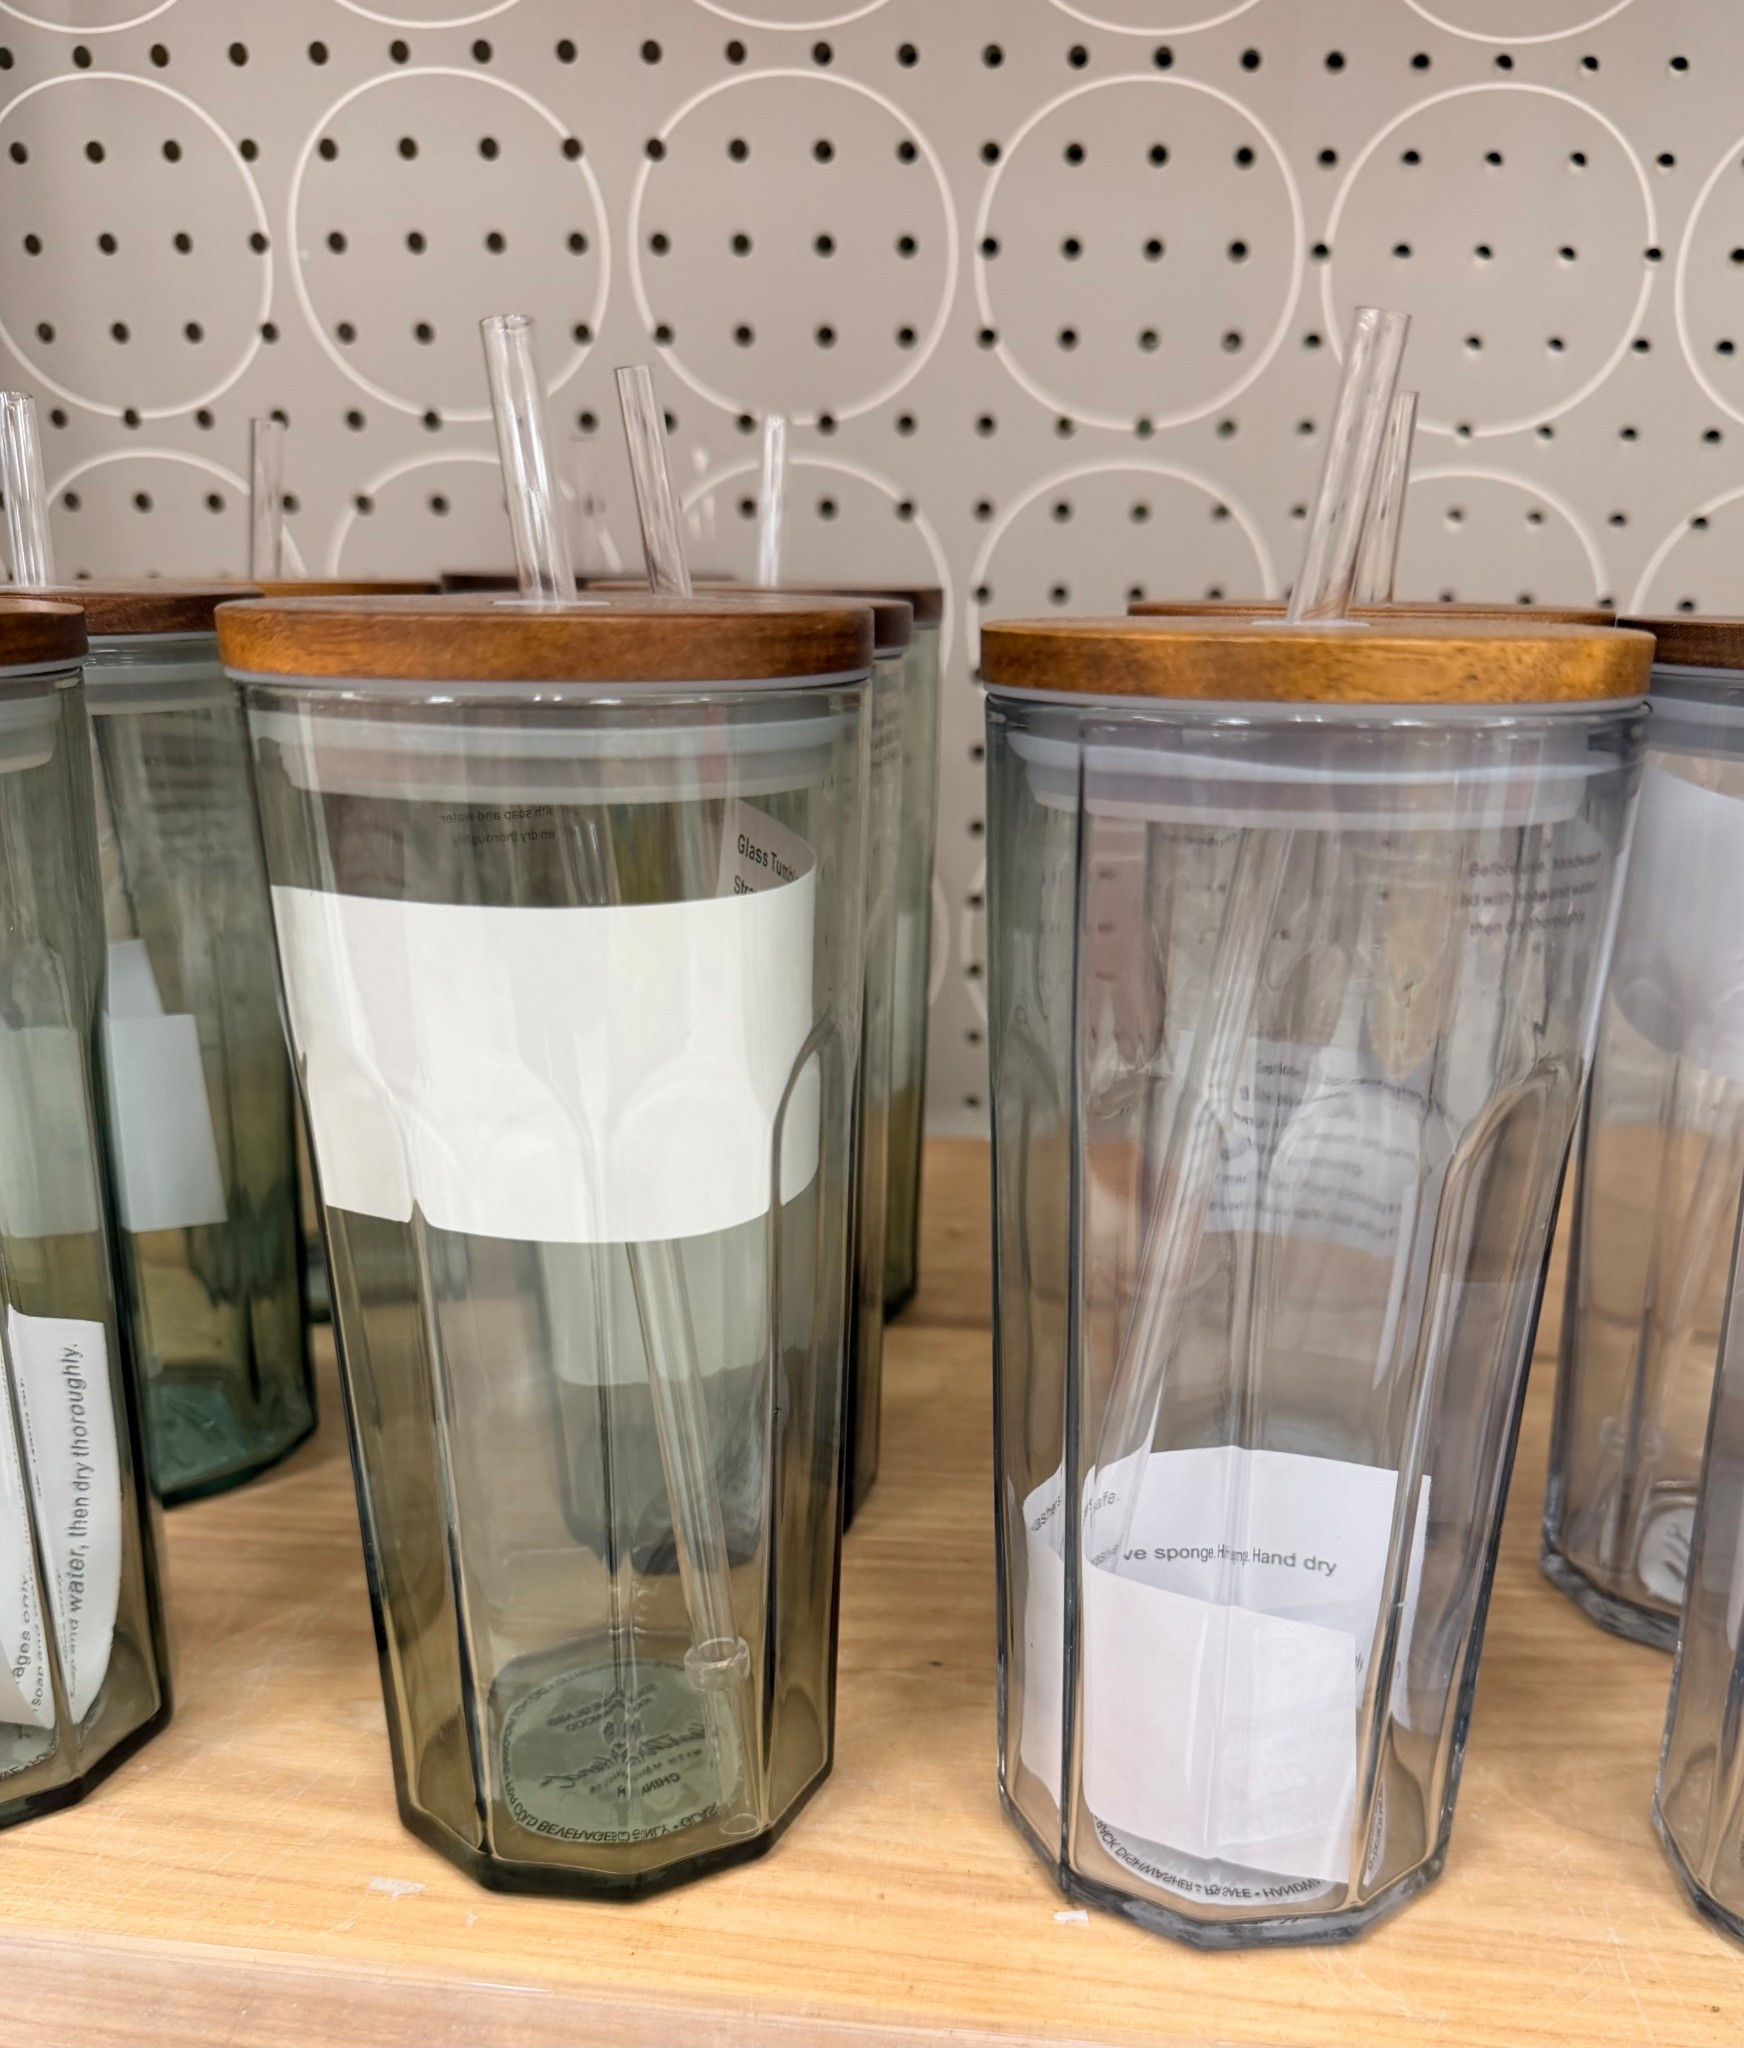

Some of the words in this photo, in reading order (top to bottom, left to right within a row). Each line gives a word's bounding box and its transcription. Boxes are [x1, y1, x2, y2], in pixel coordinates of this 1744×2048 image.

[737, 833, 768, 867] Glass
[771, 850, 799, 883] Tumbl
[61, 1343, 91, 1457] thoroughly.
[73, 1462, 95, 1491] dry
[67, 1496, 90, 1538] then
[67, 1544, 91, 1613] water,
[1154, 1545, 1216, 1562] sponge.
[1252, 1548, 1297, 1568] Hand
[1303, 1555, 1338, 1577] dry
[11, 1630, 31, 1678] ages
